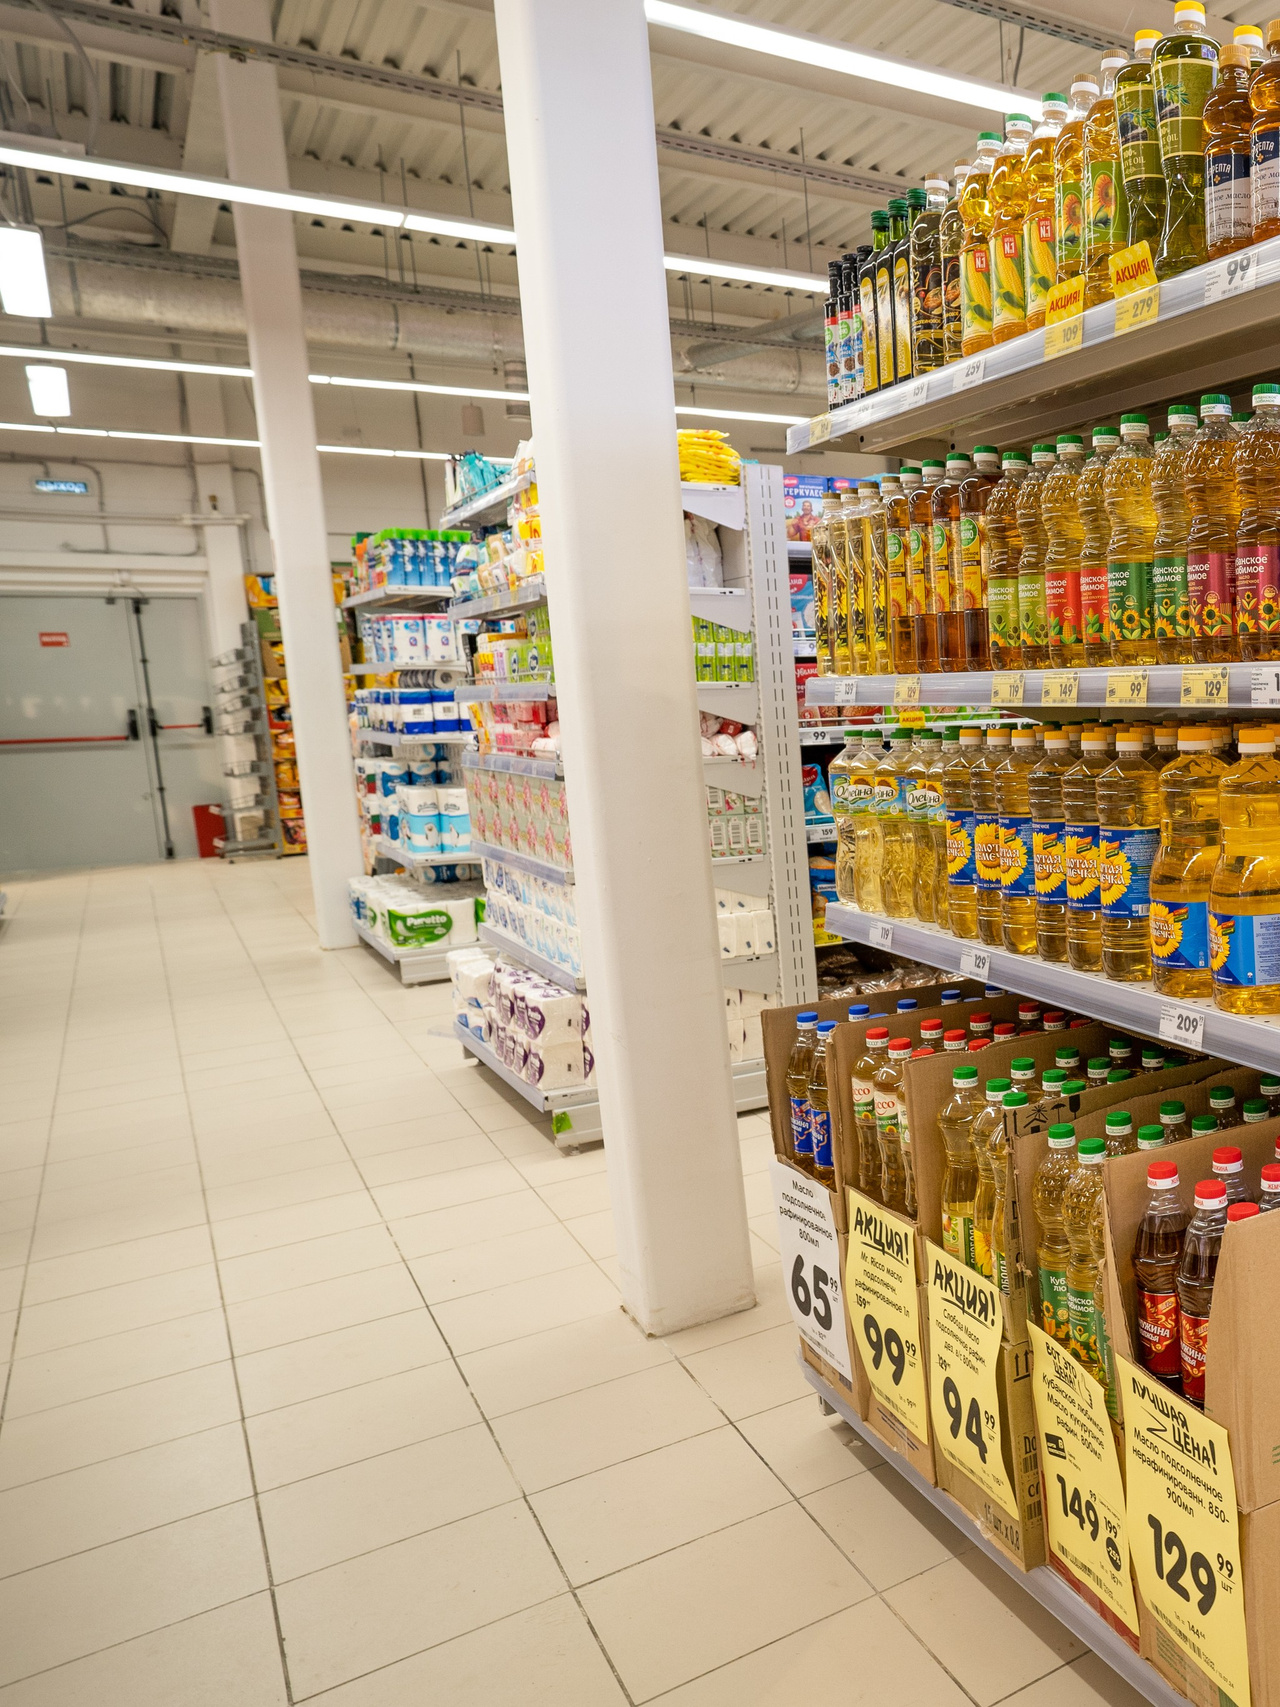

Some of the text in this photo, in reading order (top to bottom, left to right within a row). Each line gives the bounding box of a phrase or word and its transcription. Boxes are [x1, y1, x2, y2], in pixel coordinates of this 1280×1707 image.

[1115, 257, 1151, 285] АКЦИЯ!
[1226, 254, 1251, 285] 99
[1049, 288, 1081, 314] АКЦИЯ!
[1132, 297, 1154, 319] 279
[1061, 324, 1078, 343] 109
[965, 362, 981, 378] 259
[844, 682, 854, 695] 139
[907, 685, 917, 698] 129
[1009, 683, 1019, 698] 119
[1058, 683, 1074, 697] 149
[1130, 681, 1142, 696] 99
[1203, 680, 1222, 696] 129
[813, 731, 826, 741] 99
[880, 927, 890, 940] 119
[973, 956, 987, 971] 129
[1177, 1014, 1198, 1034] 209
[792, 1180, 814, 1198] Масло
[779, 1206, 833, 1240] рафинированное
[799, 1228, 820, 1248] 800мл
[854, 1207, 910, 1265] АКЦИЯ!
[860, 1251, 903, 1283] Mr. Ricco масло
[791, 1254, 838, 1331] 65 99
[854, 1278, 903, 1314] рафинированное
[933, 1259, 996, 1327] АКЦИЯ!
[943, 1308, 980, 1345] Слобода Масло
[864, 1314, 917, 1386] 99 99
[935, 1319, 987, 1368] подсолнечное рафин.
[962, 1355, 979, 1375] 800мл
[1046, 1342, 1077, 1378] ВОТ ЭТО
[1053, 1359, 1076, 1389] ЦЕНА!
[1042, 1372, 1105, 1436] Кубанское любимое
[1132, 1377, 1190, 1433] ЛУЧШАЯ
[943, 1376, 996, 1465] 94 99
[1047, 1392, 1105, 1450] Масло кукурузное
[1056, 1415, 1102, 1462] рафин. 800мл
[1171, 1423, 1218, 1476] ЦЕНА!
[1133, 1427, 1224, 1502] Масло подсолнечное
[1132, 1445, 1230, 1523] нерафинированн. 850-
[1056, 1473, 1099, 1542] 149
[1089, 1489, 1097, 1502] 99
[1166, 1487, 1195, 1517] 900мл
[1104, 1516, 1118, 1539] 199
[1147, 1513, 1234, 1616] 129 99
[1221, 1580, 1234, 1594] шт
